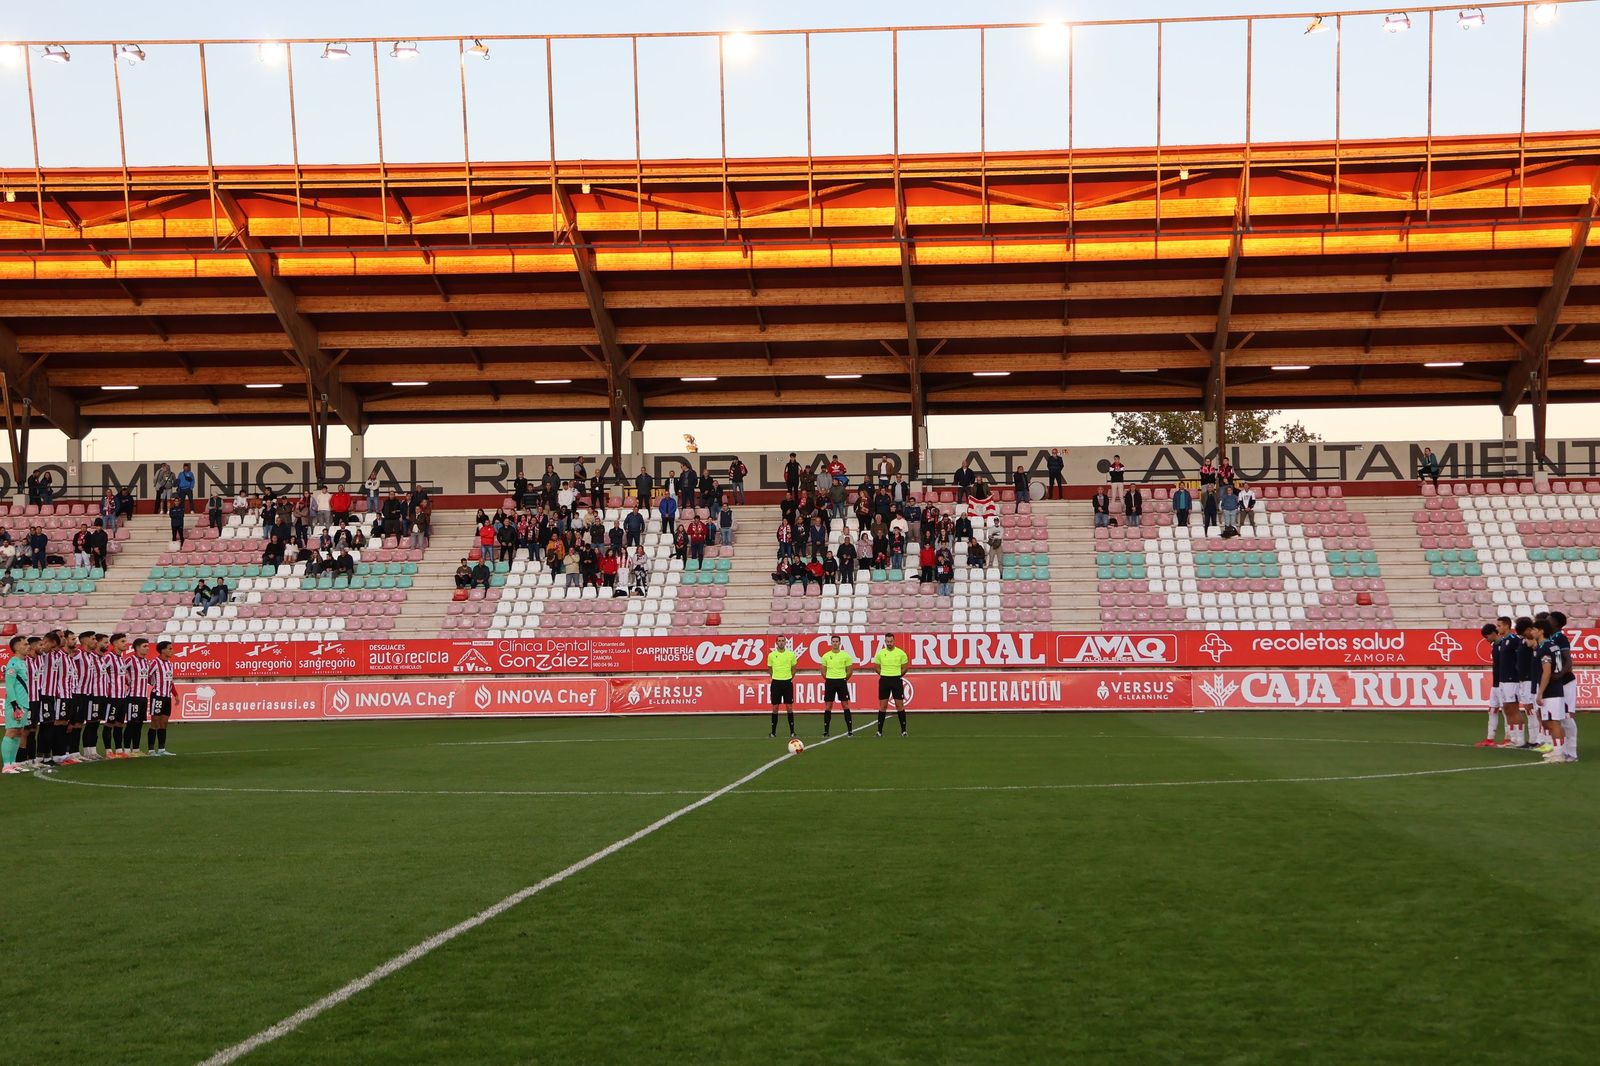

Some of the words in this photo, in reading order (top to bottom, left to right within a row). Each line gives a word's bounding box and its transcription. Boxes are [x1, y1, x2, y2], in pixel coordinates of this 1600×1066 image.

[498, 640, 543, 652] Clínica
[546, 639, 590, 652] Dental
[1252, 632, 1347, 651] recoletas
[1352, 632, 1405, 651] salud
[636, 645, 695, 655] CARPINTERÍA
[911, 633, 1046, 665] RURAL
[1063, 636, 1166, 662] AMAQ
[235, 657, 292, 671] sangregorio
[299, 655, 356, 670] sangregorio
[654, 654, 680, 662] HIJOS
[1343, 653, 1406, 663] ZAMORA
[174, 659, 221, 672] ngregorio
[641, 686, 703, 698] VERSUS
[961, 677, 1062, 702] FEDERACIÓN
[1111, 681, 1174, 693] VERSUS
[1241, 673, 1341, 706] CAJA
[1348, 672, 1491, 707] RURAL
[355, 692, 412, 707] INNOVA
[416, 691, 455, 709] Chef
[497, 689, 554, 704] INNOVA
[557, 688, 597, 706] Chef
[185, 700, 209, 712] Susi
[214, 699, 316, 712] casqueriasusi.es
